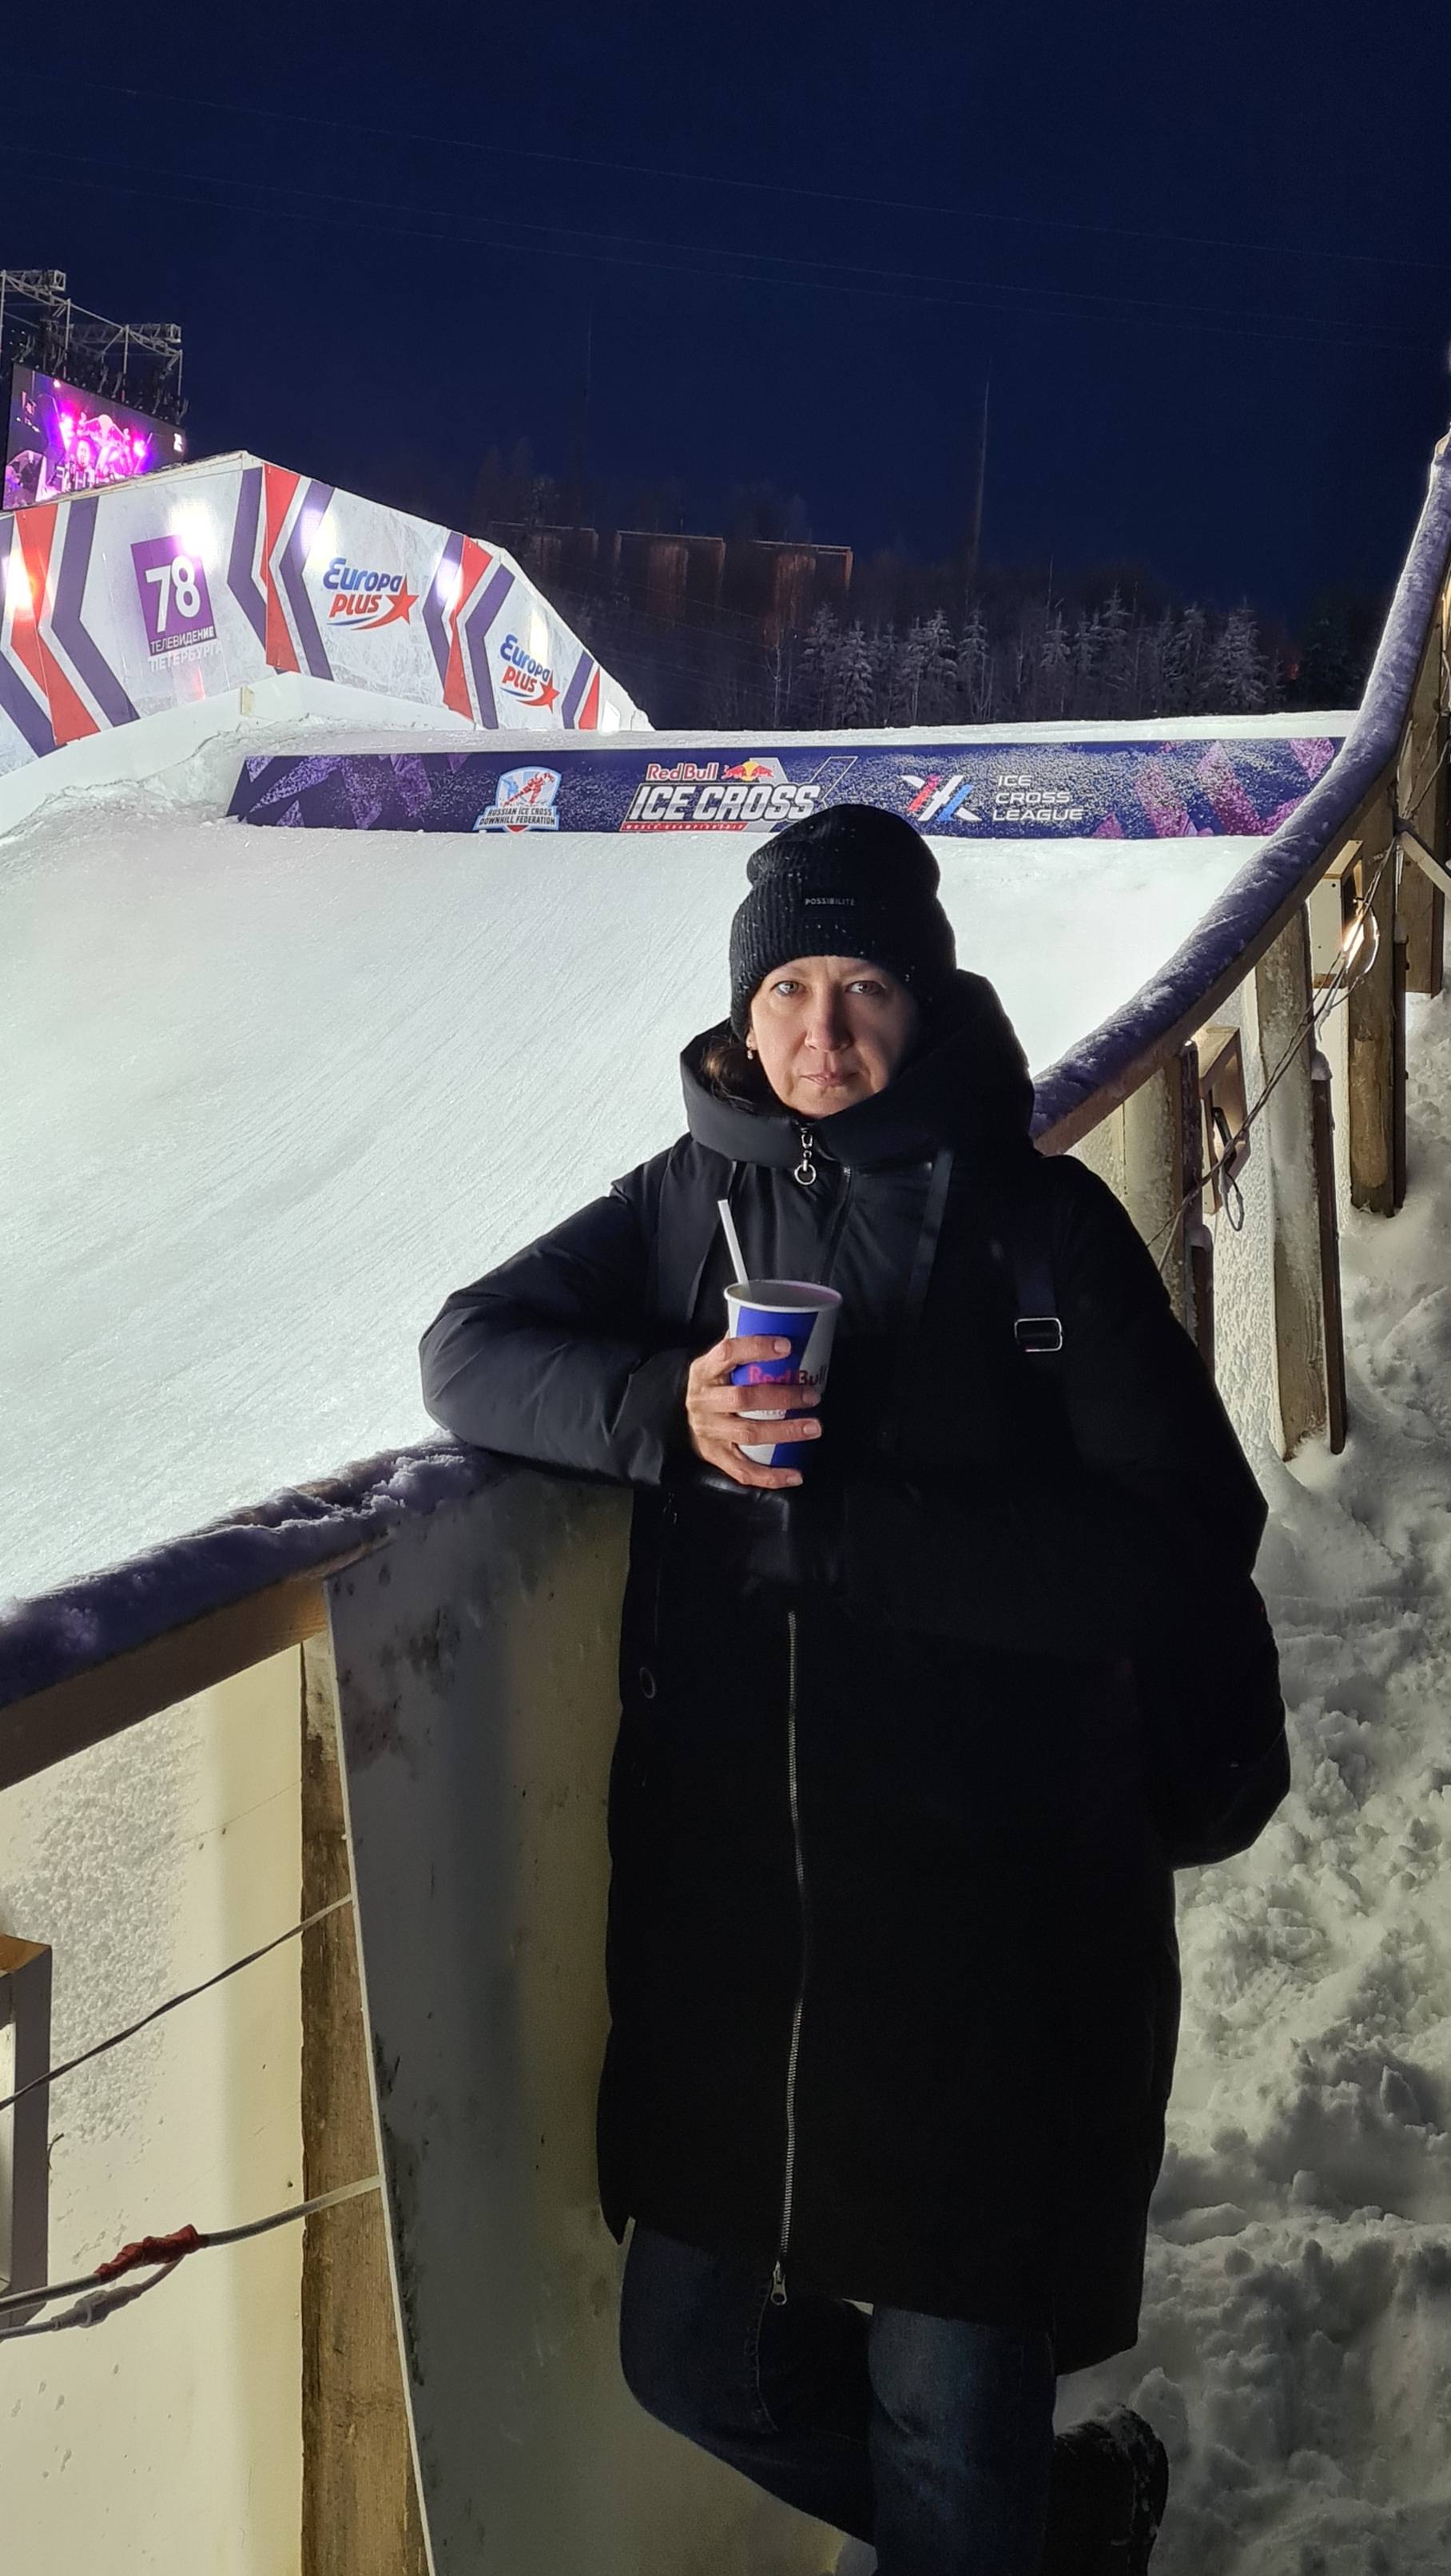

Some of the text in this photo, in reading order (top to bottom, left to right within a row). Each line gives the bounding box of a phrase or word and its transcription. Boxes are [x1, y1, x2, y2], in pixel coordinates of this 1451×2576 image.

[323, 558, 403, 593] Europa
[145, 555, 201, 633] 78
[328, 593, 383, 618] PLUS
[150, 625, 215, 654] ТЕЛЕВИДЕНИЕ
[149, 640, 224, 673] ПЕТЕРБУРГА
[499, 634, 553, 680] Europa
[501, 665, 538, 693] PLUS
[646, 763, 718, 781] Red Bull
[997, 775, 1032, 787] ICE
[628, 785, 821, 821] ICE CROSS
[995, 792, 1070, 804] CROSS
[479, 816, 555, 825] DOWNHILL FEDERATION
[992, 808, 1084, 821] LEAGUE
[748, 1366, 792, 1384] Red
